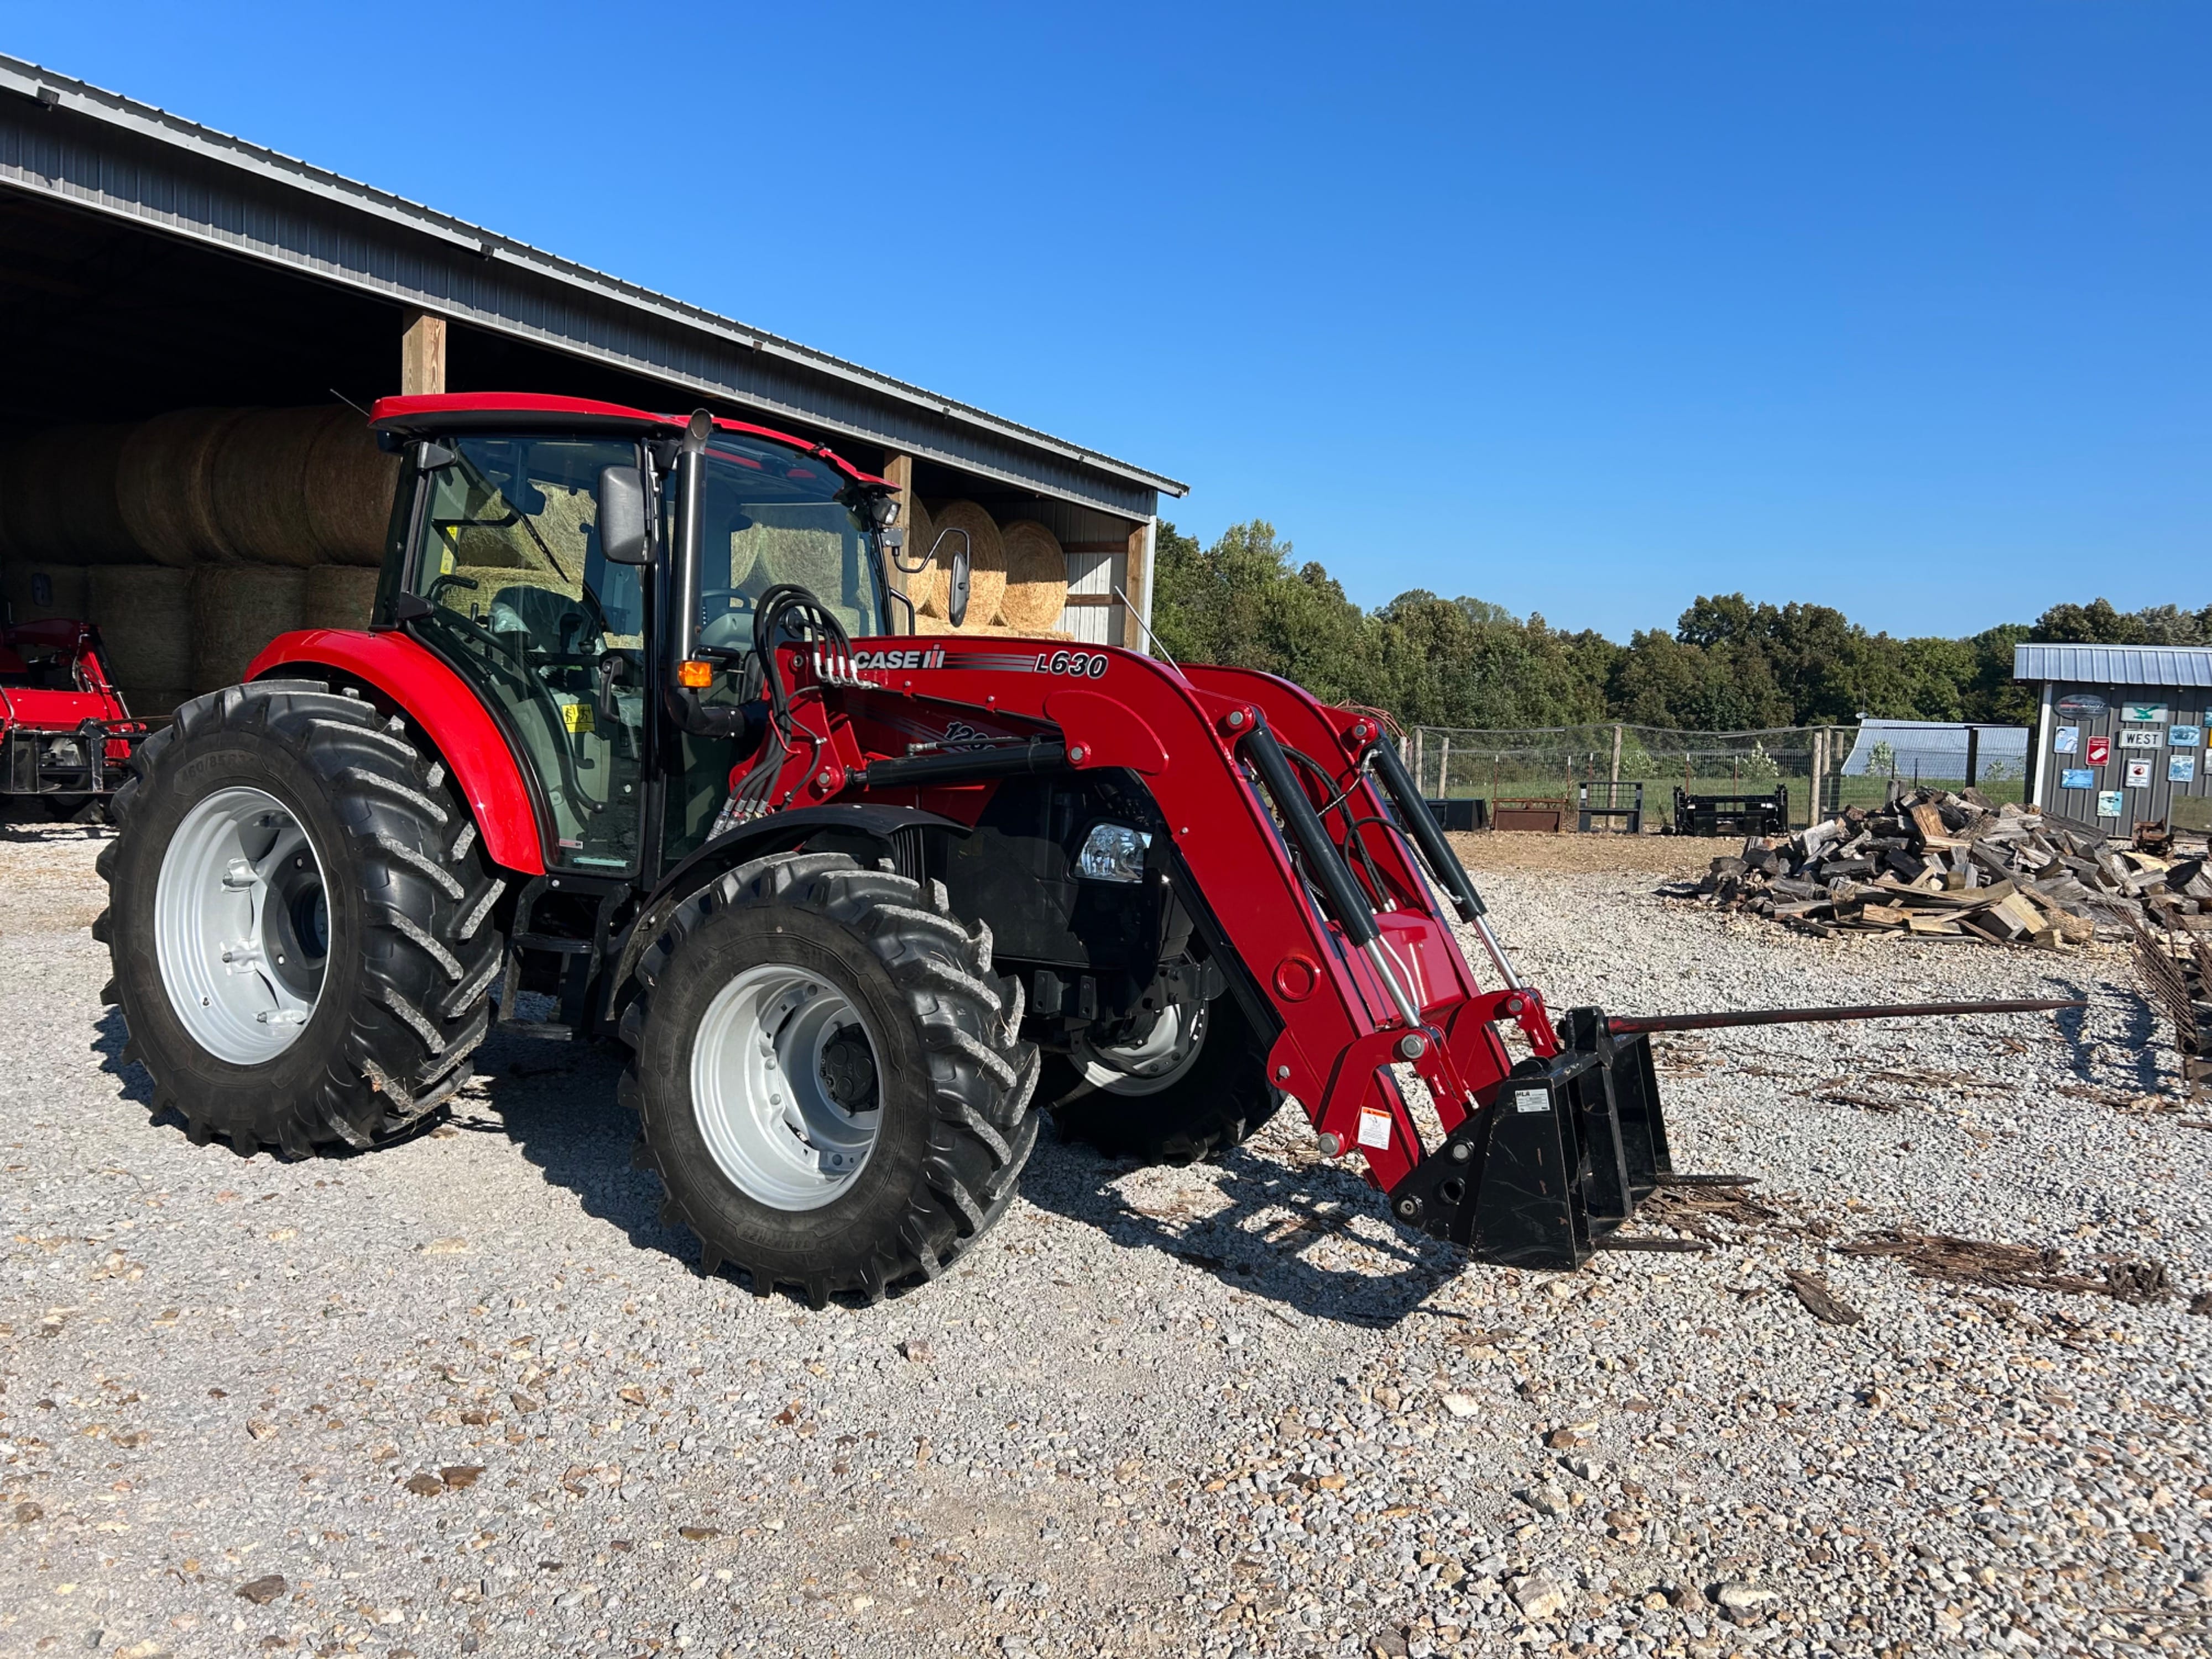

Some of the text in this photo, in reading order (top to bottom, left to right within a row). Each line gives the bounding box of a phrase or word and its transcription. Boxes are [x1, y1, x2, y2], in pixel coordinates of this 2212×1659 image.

[854, 651, 921, 669] CASE
[1034, 650, 1109, 679] L630
[2127, 733, 2158, 744] WEST
